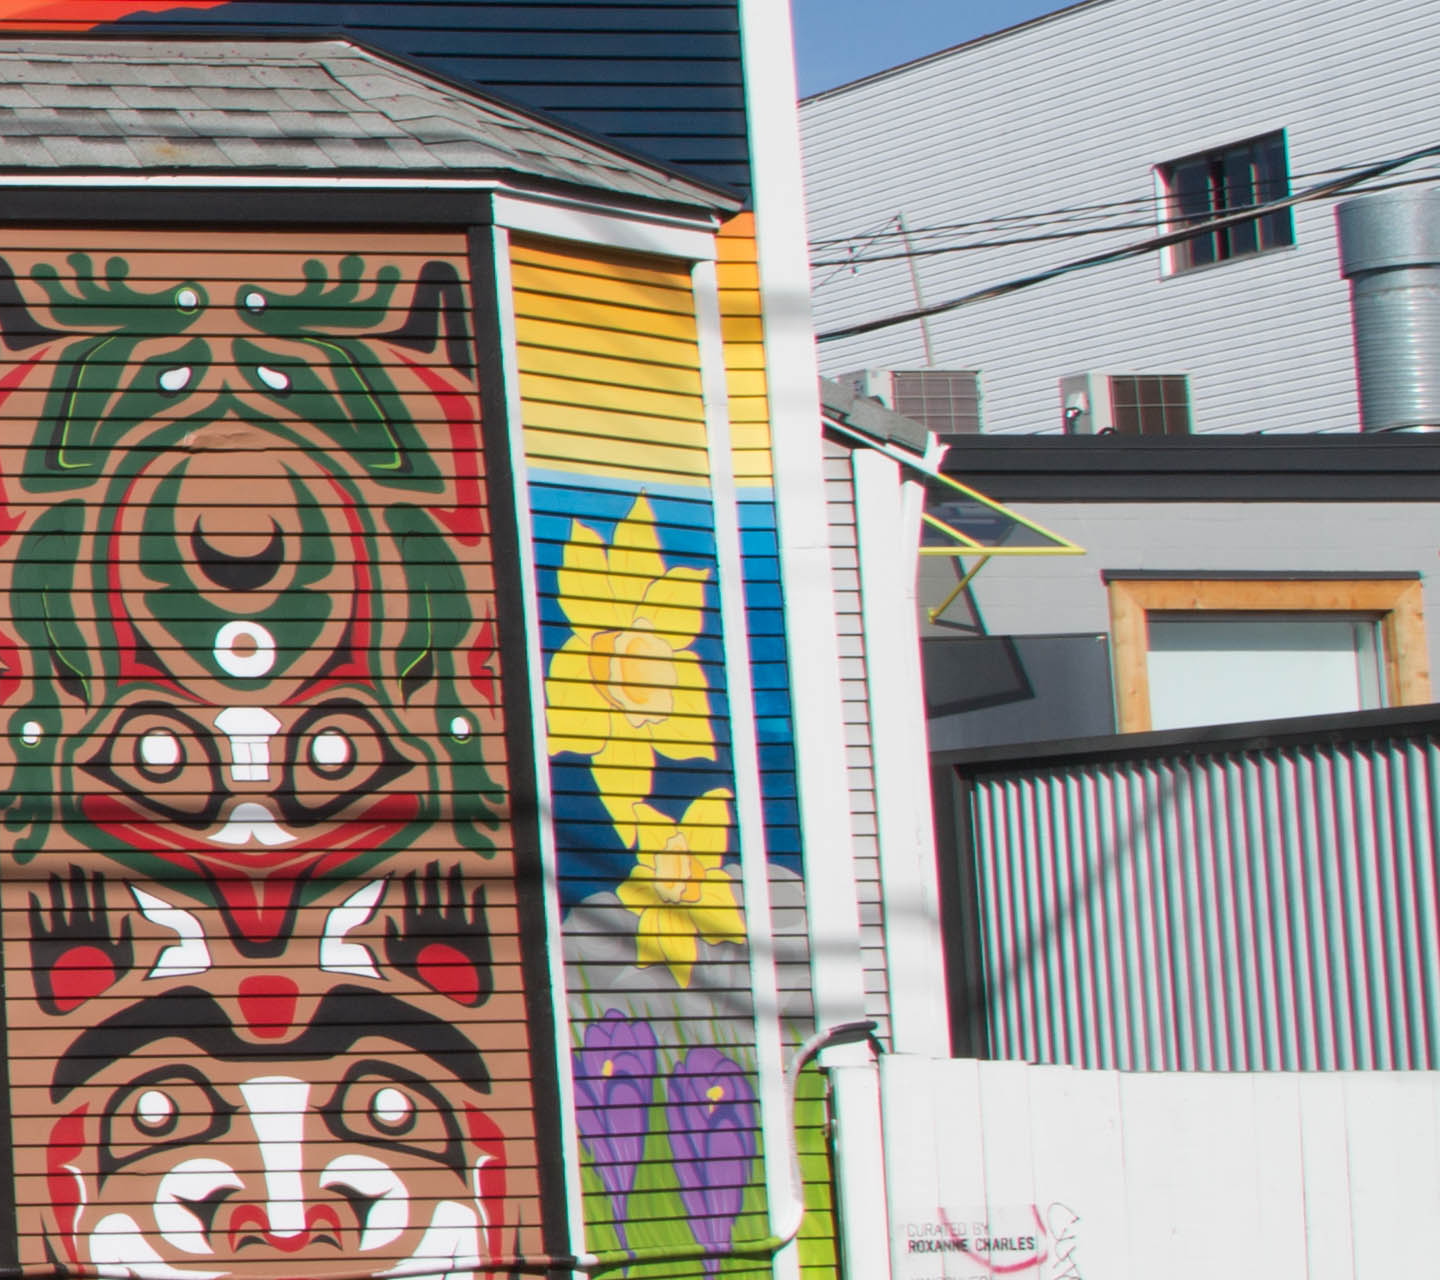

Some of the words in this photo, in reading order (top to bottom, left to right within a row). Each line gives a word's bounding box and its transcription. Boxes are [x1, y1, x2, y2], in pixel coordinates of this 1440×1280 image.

[907, 1222, 967, 1237] CURATED
[972, 1222, 989, 1236] BY
[907, 1238, 969, 1254] ROXANNE
[974, 1235, 1035, 1252] CHARLES
